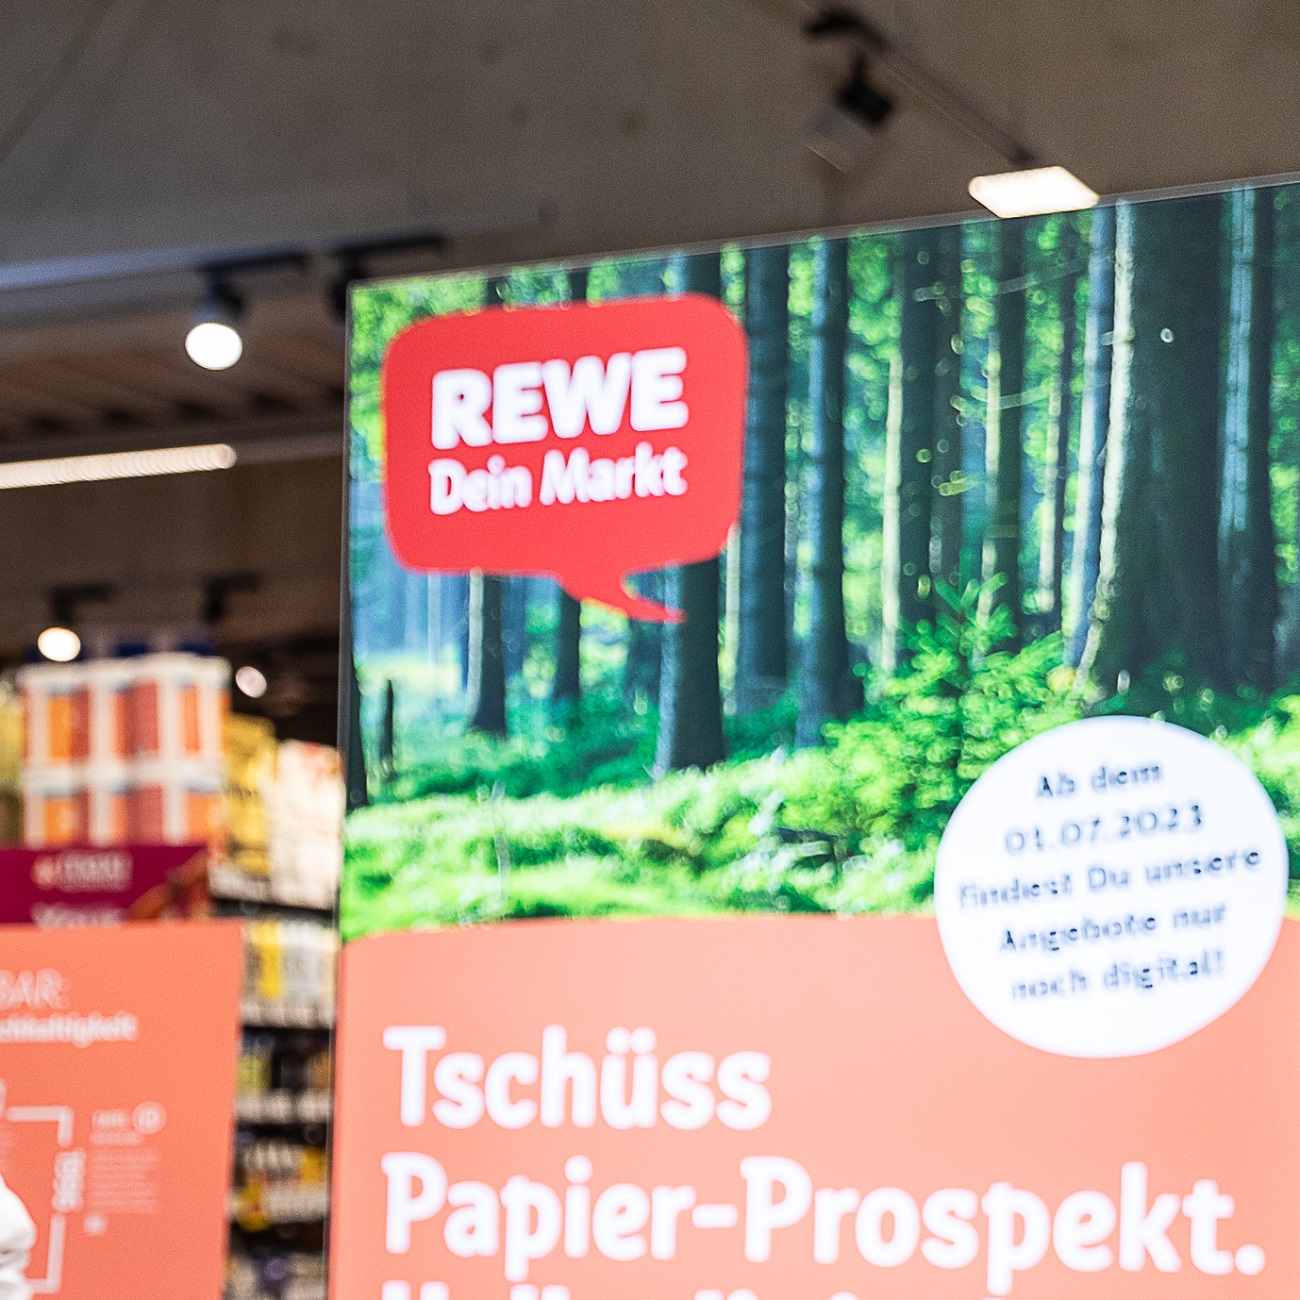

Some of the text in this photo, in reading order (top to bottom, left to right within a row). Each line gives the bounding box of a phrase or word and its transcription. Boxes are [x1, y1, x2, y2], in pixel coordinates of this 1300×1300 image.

[431, 347, 688, 450] REWE
[429, 442, 688, 515] Dein Markt
[1037, 765, 1161, 798] Ab dem
[1087, 865, 1131, 892] Du
[1145, 850, 1260, 882] unsere
[1000, 904, 1226, 951] Angebote nur
[1011, 948, 1225, 999] noch digital!
[382, 1024, 773, 1130] Tschüss
[380, 1151, 1267, 1298] Papier-Prospekt.
